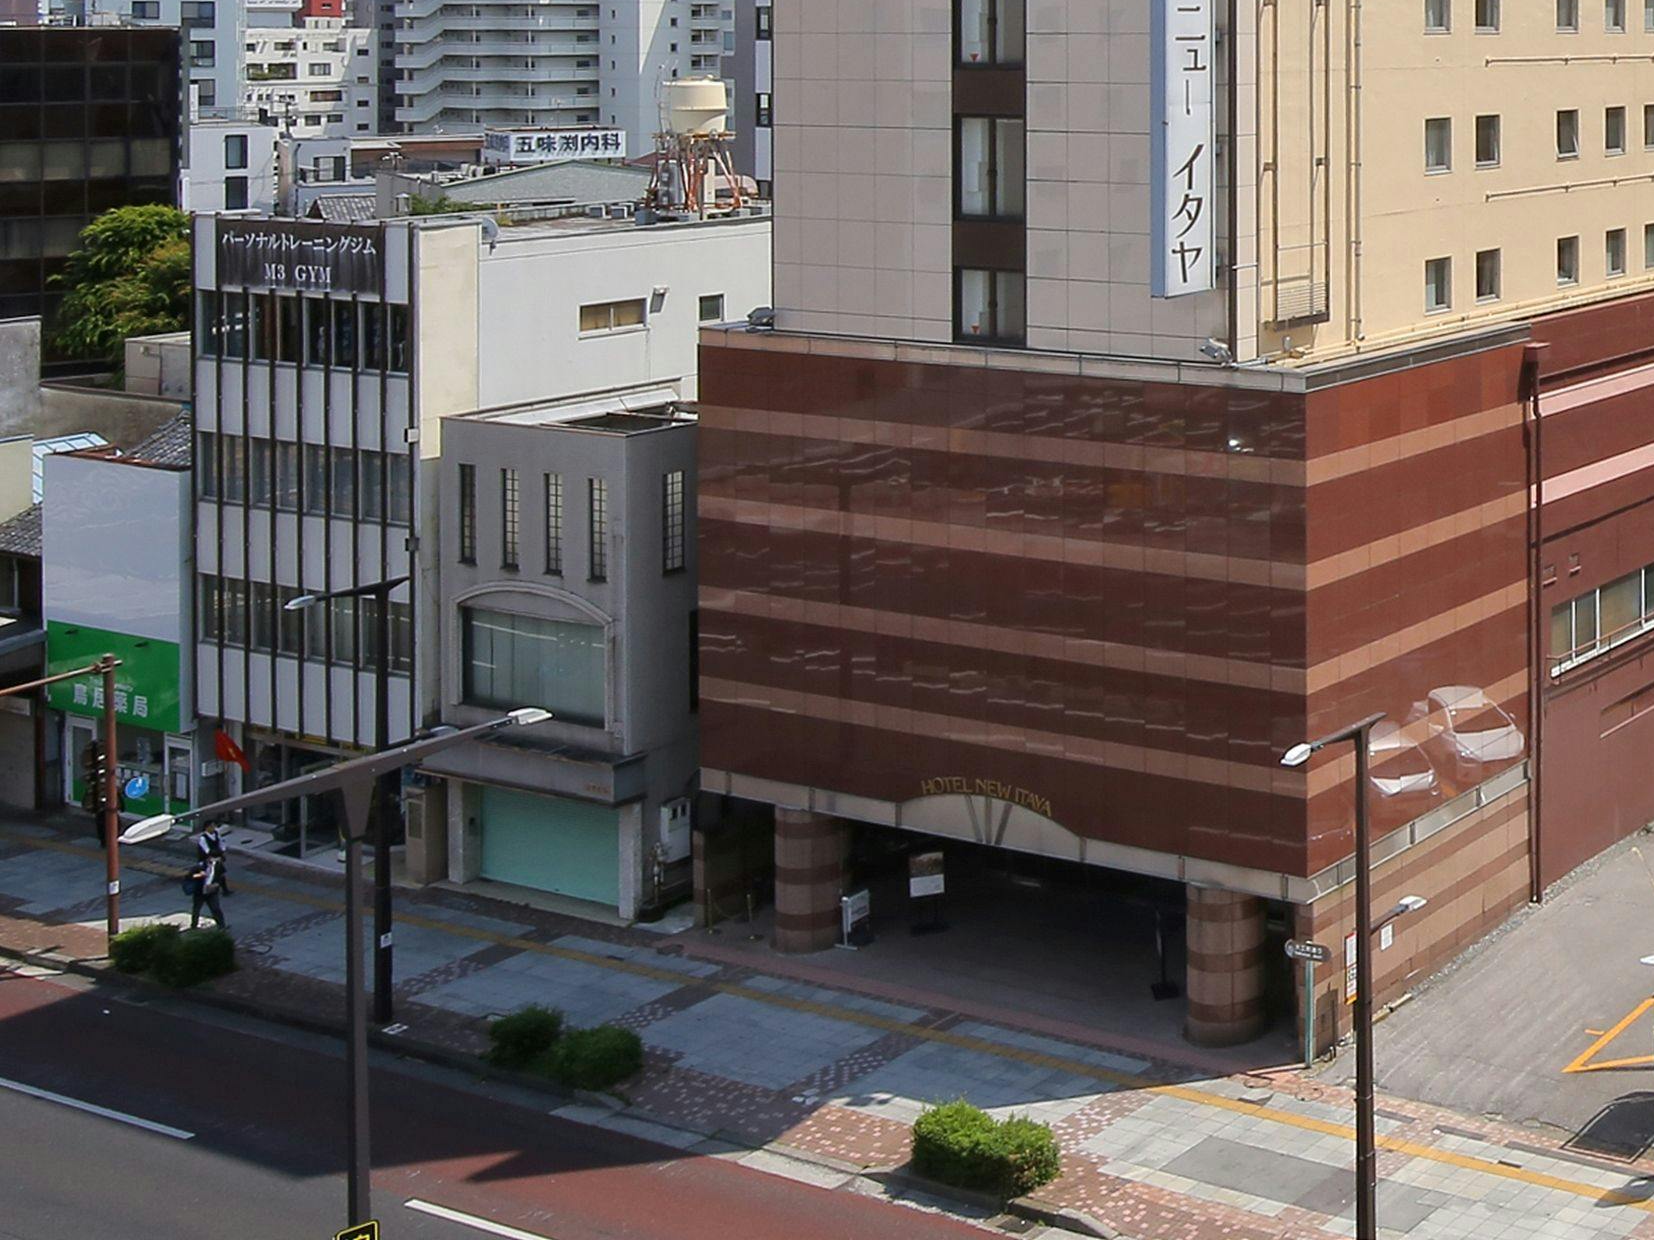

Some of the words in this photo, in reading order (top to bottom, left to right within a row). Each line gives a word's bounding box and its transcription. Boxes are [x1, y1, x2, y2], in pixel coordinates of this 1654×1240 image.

[222, 230, 377, 256] パーソナルトレーニングジム
[265, 262, 287, 281] M3
[294, 264, 332, 284] GYM
[921, 776, 973, 795] HOTEL
[975, 778, 1012, 800] NEW
[1015, 787, 1052, 817] ITAYA
